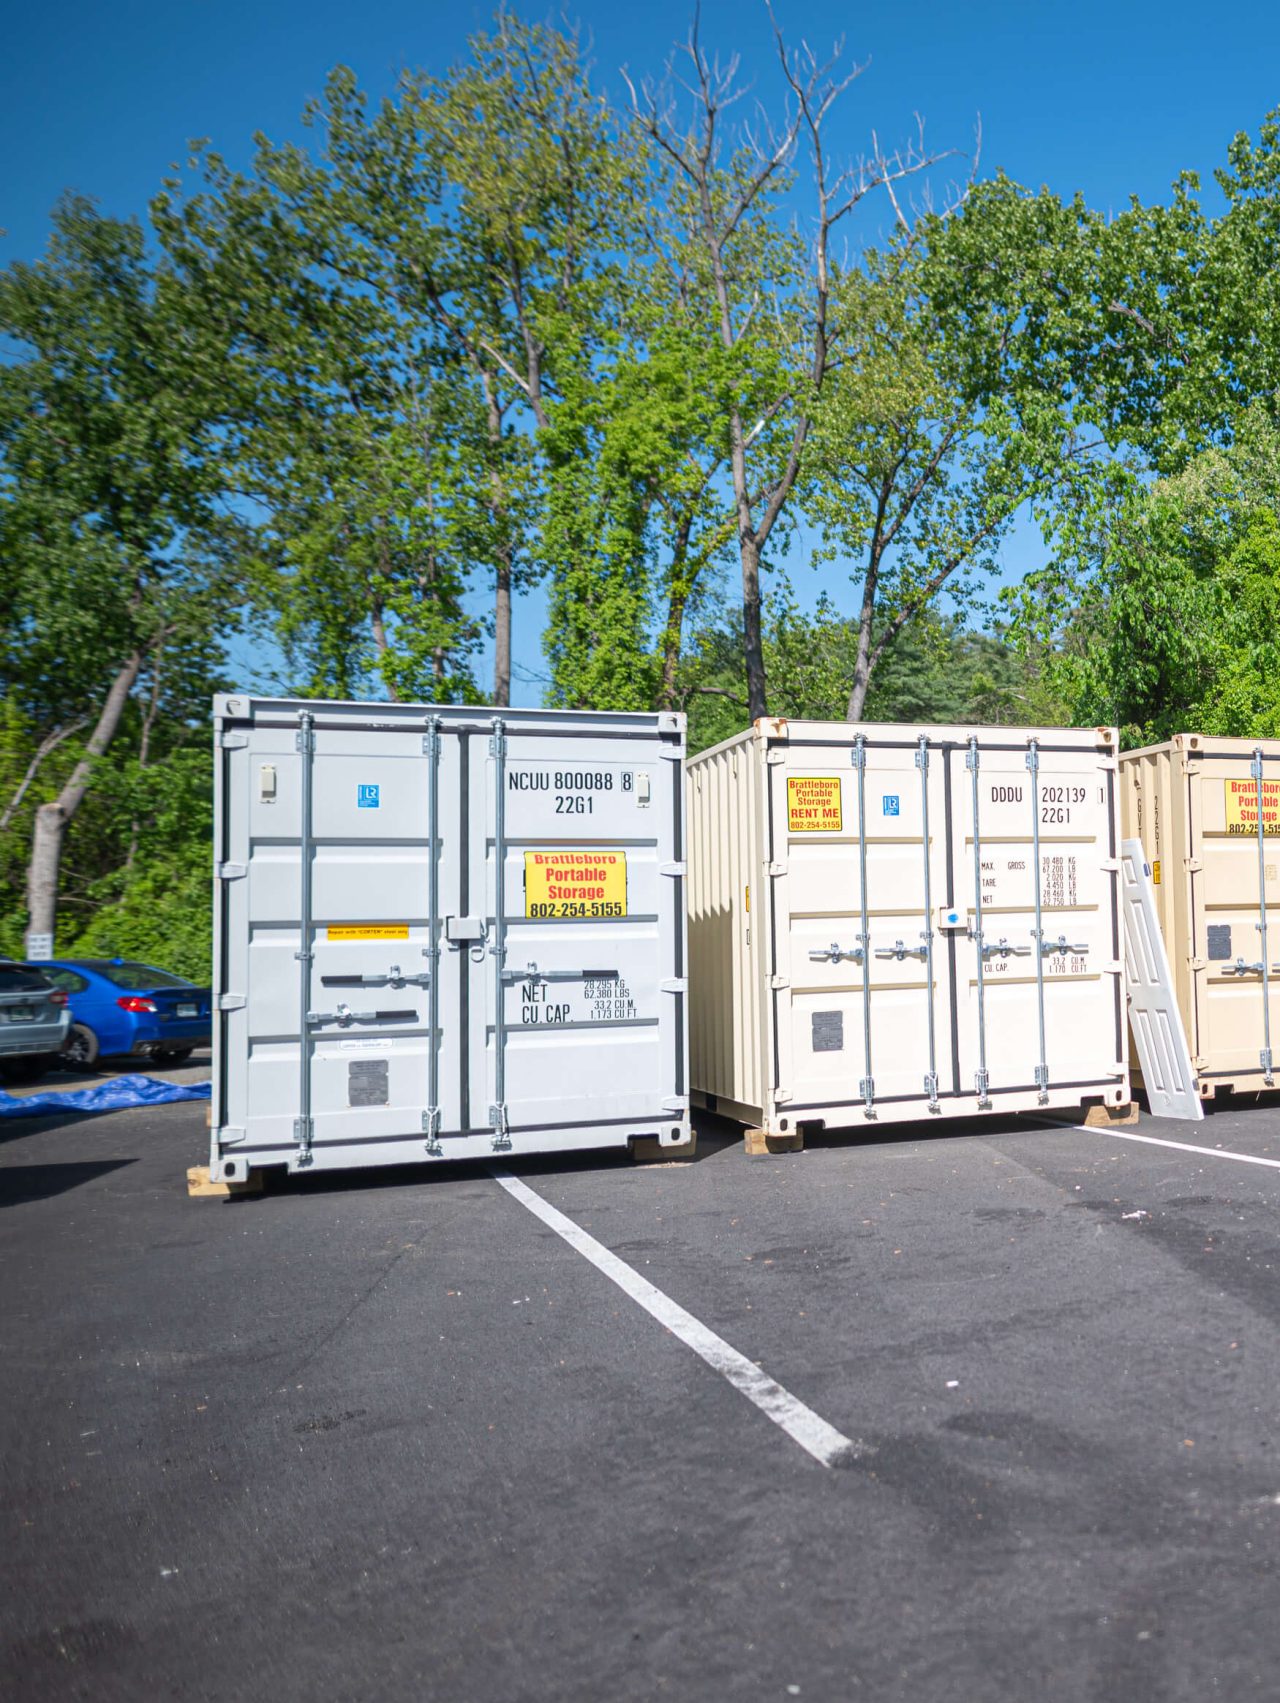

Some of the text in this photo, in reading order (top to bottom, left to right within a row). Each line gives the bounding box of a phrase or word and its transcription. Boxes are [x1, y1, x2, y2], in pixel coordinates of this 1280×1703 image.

[509, 772, 631, 790] NCUU 800088 8
[790, 780, 838, 789] Brattleboro
[796, 789, 833, 797] Portable
[991, 787, 1022, 803] DDDU
[1042, 787, 1086, 803] 202139
[555, 796, 593, 813] 22G1
[798, 797, 831, 807] Storage
[791, 809, 839, 818] RENT ME
[1042, 808, 1070, 823] 22G1
[790, 821, 840, 829] 802-254-5155
[535, 854, 616, 864] Brattleboro
[1068, 857, 1076, 865] KG
[1008, 861, 1026, 870] GROSS
[546, 868, 607, 881] Portable
[982, 879, 996, 887] TARE
[548, 885, 604, 900] Storage
[982, 895, 993, 904] NET
[530, 902, 622, 917] 802-254-5155
[615, 979, 625, 989] KG
[522, 984, 548, 1002] NET
[615, 989, 630, 998] LBS
